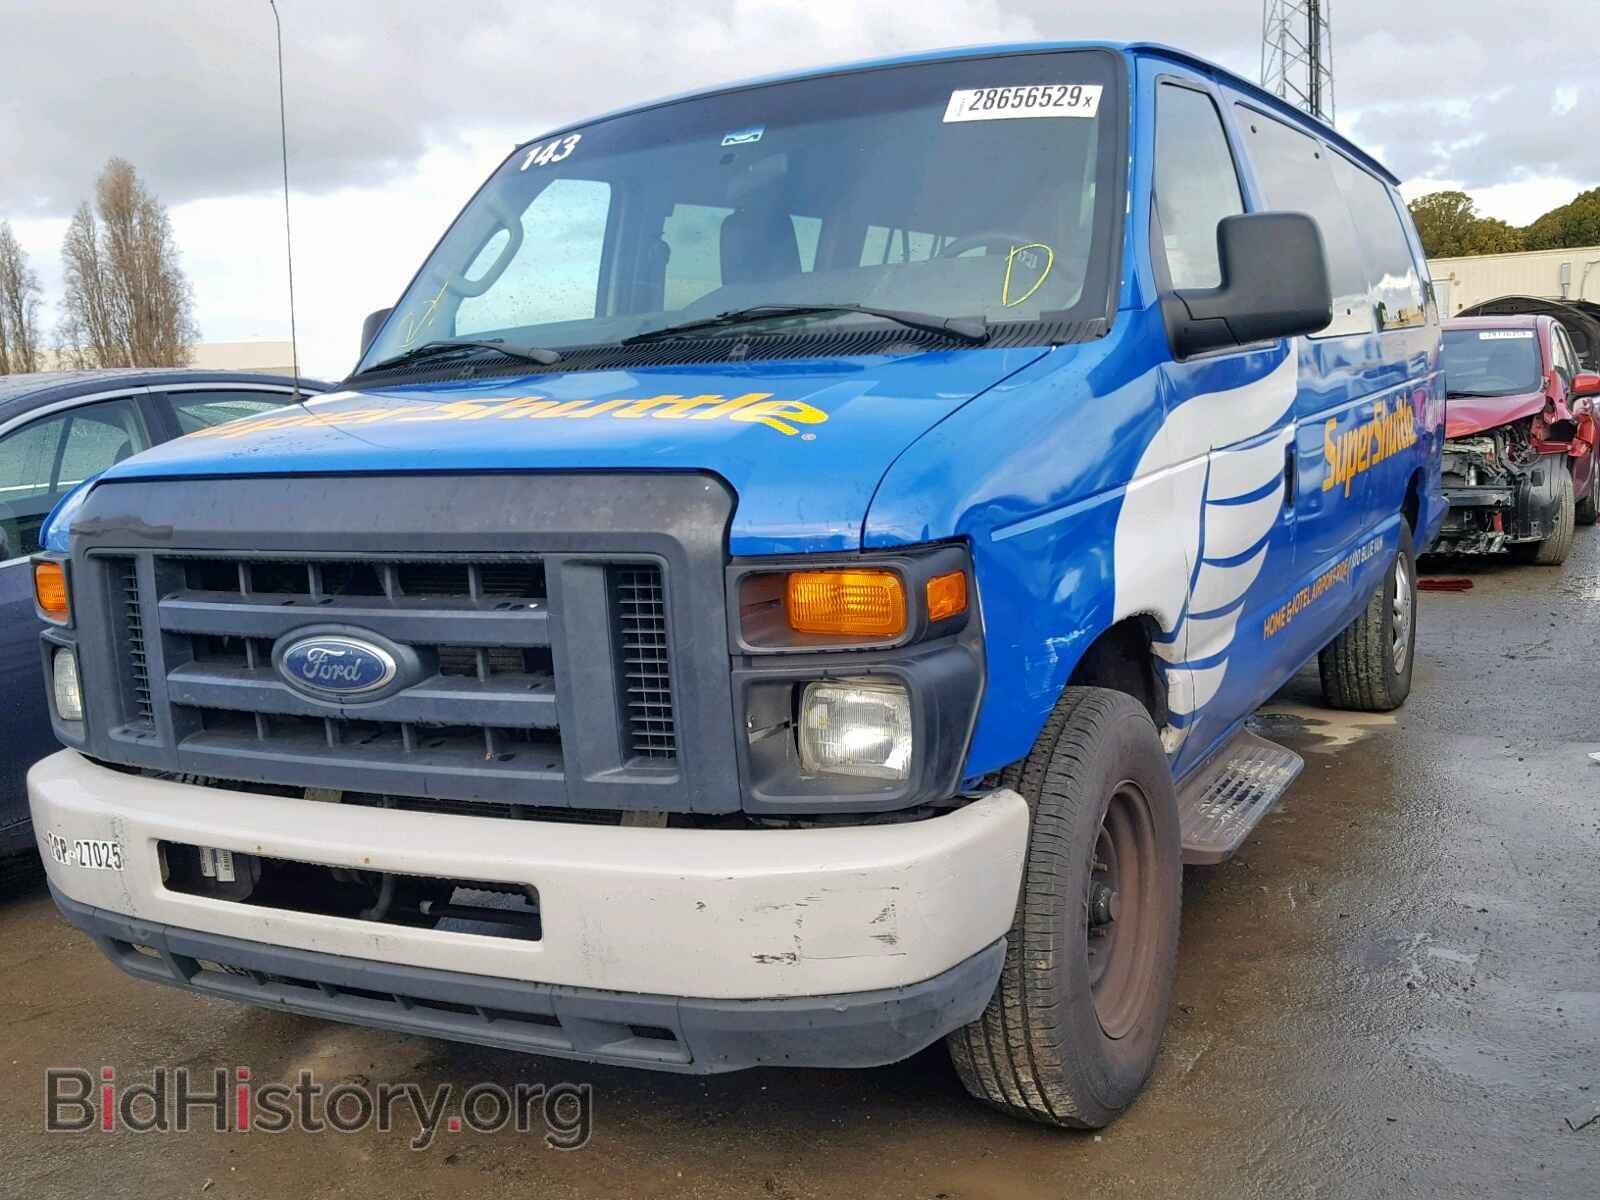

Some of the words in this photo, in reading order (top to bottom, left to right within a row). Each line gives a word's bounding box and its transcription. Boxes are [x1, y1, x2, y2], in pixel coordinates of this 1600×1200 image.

[520, 134, 582, 171] 143
[1001, 242, 1054, 307] D
[1322, 392, 1418, 498] SuperShuttle
[303, 647, 362, 681] Ford
